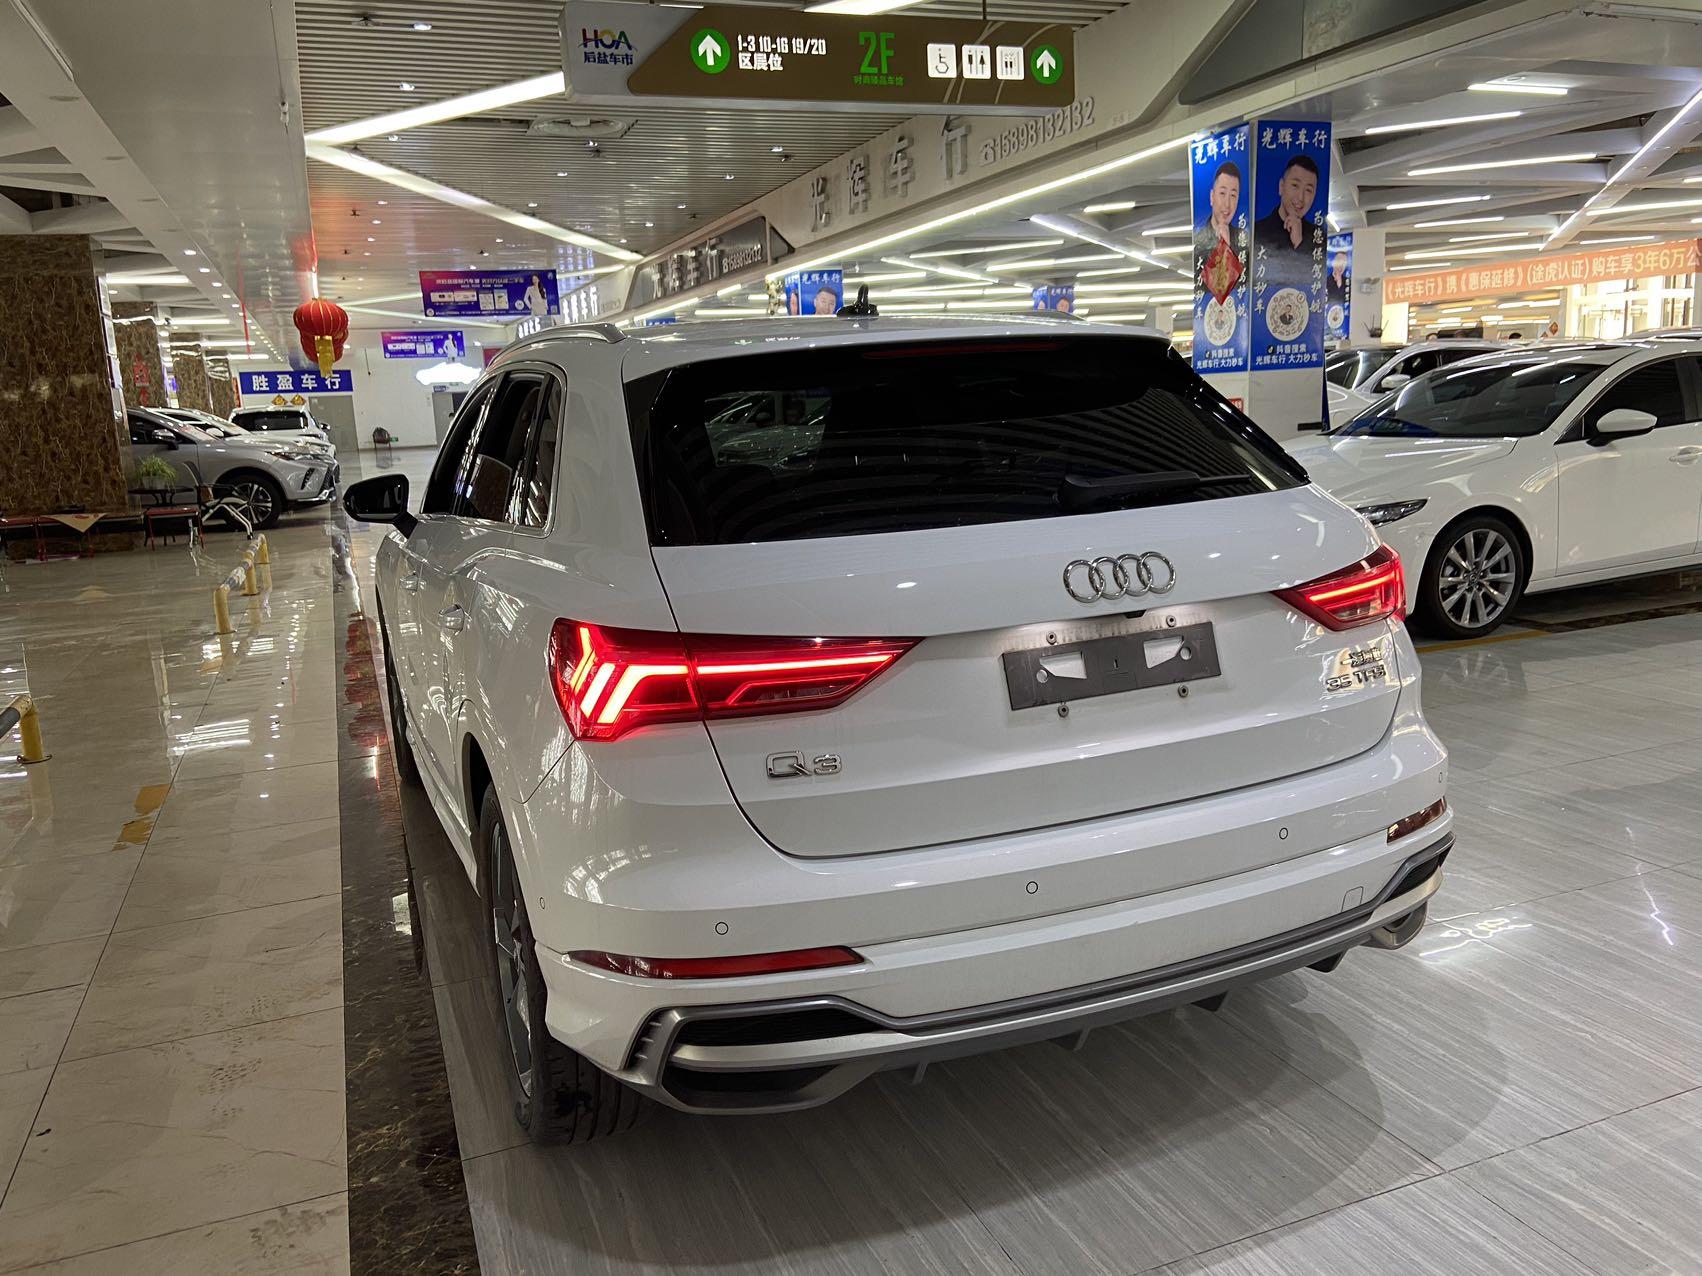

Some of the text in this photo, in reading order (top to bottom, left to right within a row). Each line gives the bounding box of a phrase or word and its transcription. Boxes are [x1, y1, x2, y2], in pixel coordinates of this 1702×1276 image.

[581, 28, 633, 50] HOA
[737, 34, 827, 55] 1-3 10-16 19/20
[737, 52, 784, 71] 区展位
[859, 31, 895, 74] 2F
[995, 96, 1095, 159] 15898132132
[1261, 127, 1328, 149] 光辉车行
[1309, 210, 1325, 314] 为您保驾护航
[252, 373, 341, 392] 胜盈车行
[766, 750, 843, 779] Q3
